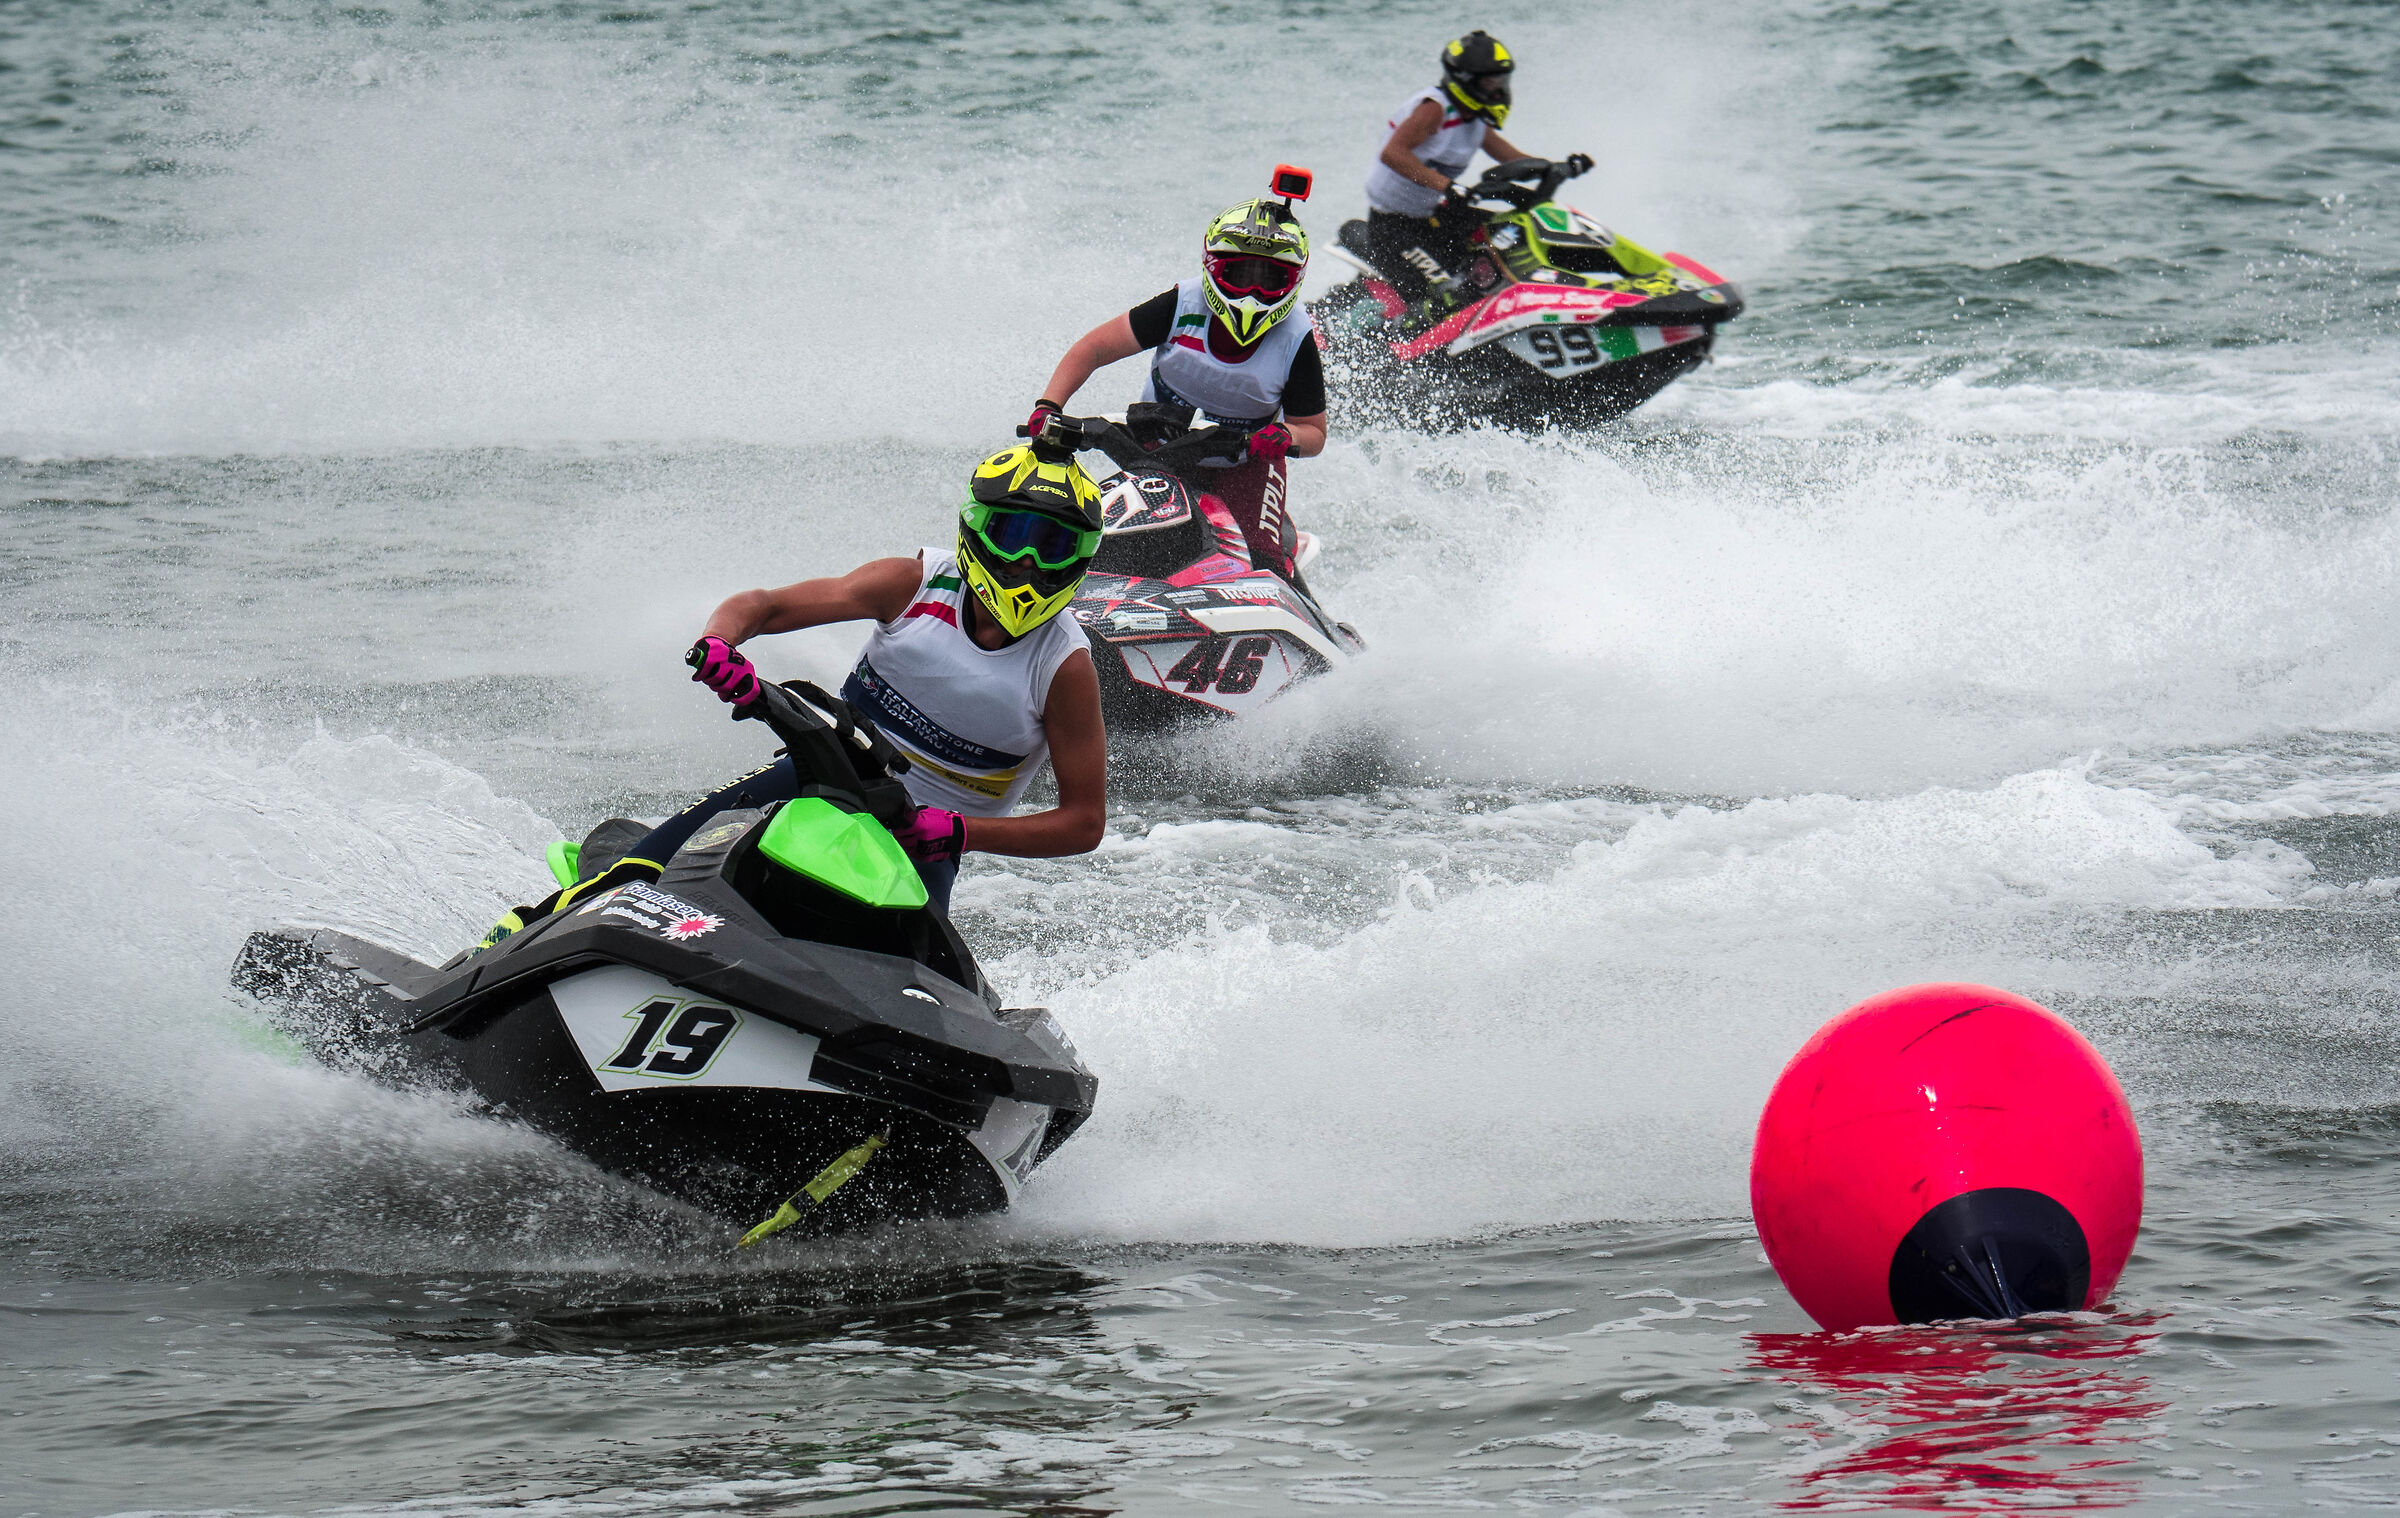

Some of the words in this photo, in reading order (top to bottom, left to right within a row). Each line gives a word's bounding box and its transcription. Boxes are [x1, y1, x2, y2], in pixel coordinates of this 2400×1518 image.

[1245, 236, 1272, 248] Airoh
[1527, 326, 1600, 369] 99
[1028, 484, 1069, 499] ACERBIS
[1143, 480, 1167, 490] 46
[1258, 463, 1285, 545] JTPLT
[1163, 636, 1273, 695] 46
[945, 771, 968, 789] Sport
[976, 786, 1001, 798] Salute
[598, 996, 742, 1079] 19
